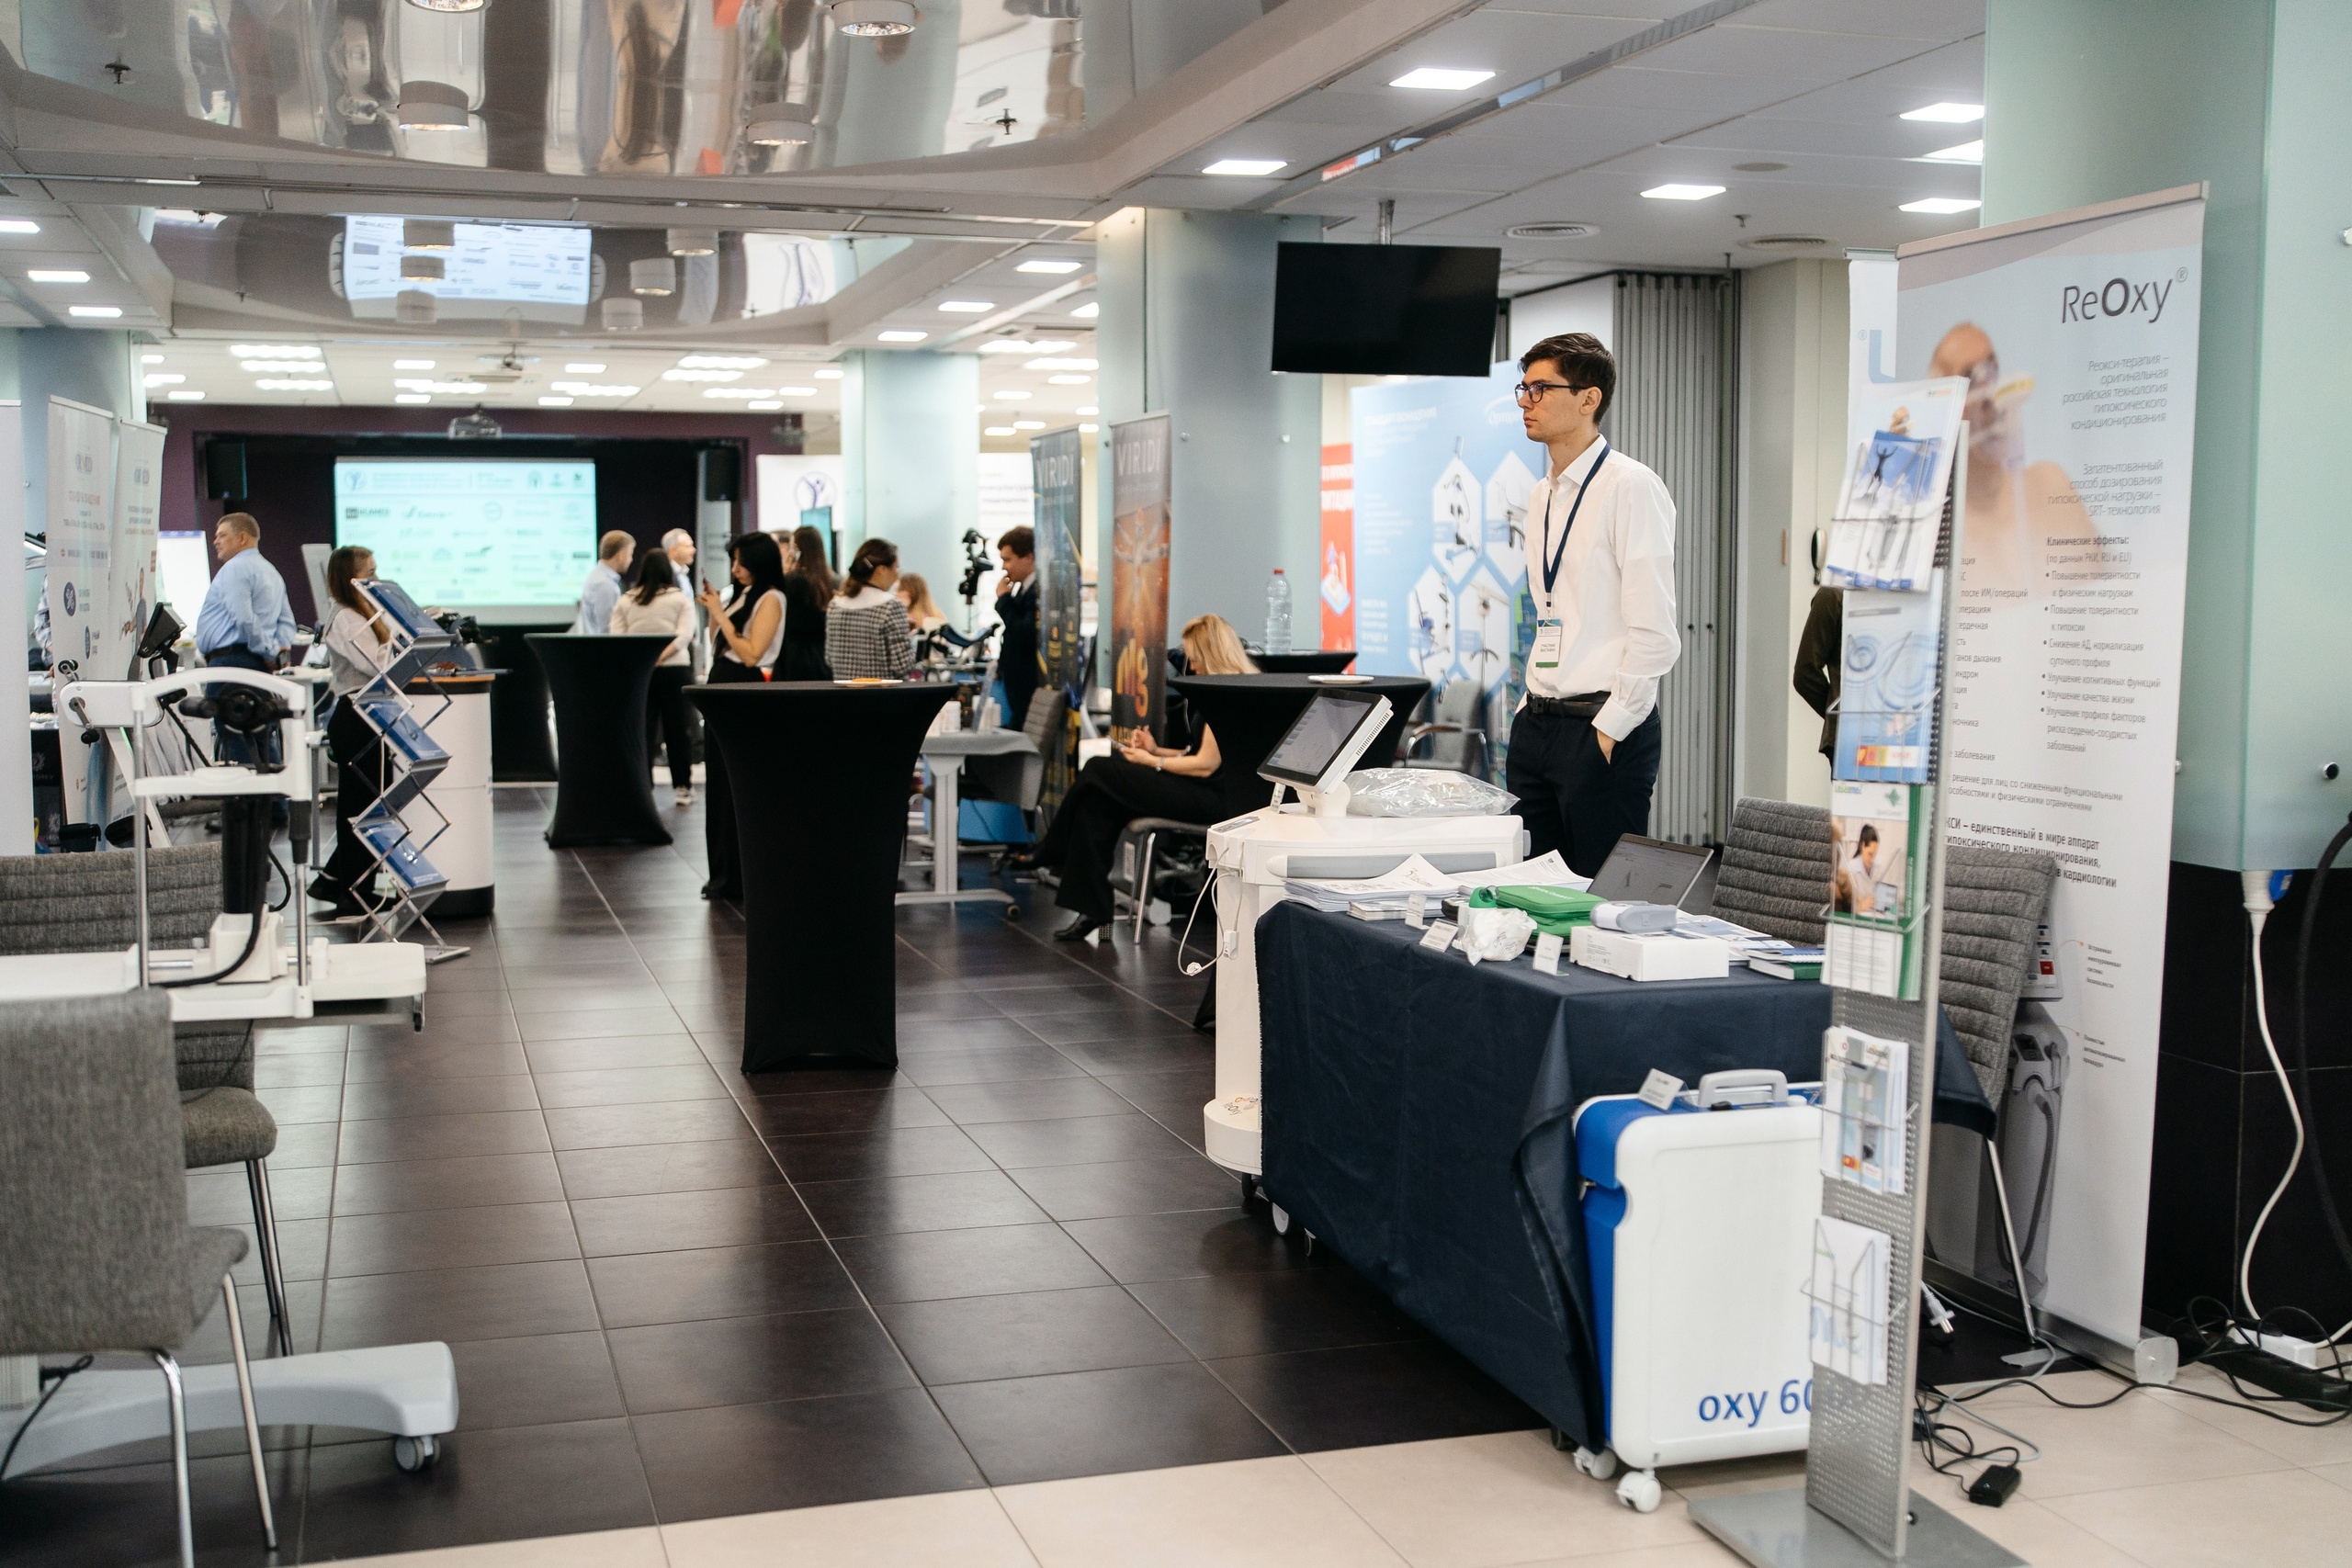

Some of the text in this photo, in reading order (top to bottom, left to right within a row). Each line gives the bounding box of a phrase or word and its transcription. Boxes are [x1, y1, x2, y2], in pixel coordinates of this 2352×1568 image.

[2088, 355, 2161, 371] Реокси-терапия
[2101, 369, 2168, 386] оригинальная
[2063, 384, 2168, 405] российская технология
[2094, 398, 2167, 413] гипоксического
[2072, 412, 2166, 430] кондиционирования
[2084, 459, 2164, 475] Запатентованный
[2071, 475, 2163, 491] способ дозирования
[2048, 491, 2109, 504] гипоксической
[2112, 491, 2153, 504] нагрузки
[2108, 504, 2161, 516] технология
[2047, 536, 2129, 547] Клинические эффекты:
[2059, 553, 2084, 564] данным
[2052, 570, 2141, 581] Повышение толерантности
[1962, 590, 1980, 598] после
[2059, 588, 2096, 599] физическим
[2098, 589, 2133, 600] нагрузкам
[2051, 604, 2139, 616] Повышение толерантности
[1959, 622, 1989, 630] ердечная
[2057, 624, 2086, 632] гипоксии
[2050, 638, 2080, 649] Снижение
[2094, 641, 2144, 651] нормализация
[2050, 658, 2110, 669] суточного профиля
[1955, 671, 1979, 680] индром
[2047, 672, 2161, 689] Улучшение когнитивных функций
[2047, 689, 2135, 705] Улучшение качества жизни
[2046, 705, 2146, 723] Улучшение профиля факторов
[2048, 725, 2138, 740] риска сердечно-сосудистых
[2047, 740, 2086, 753] заболеваний
[1954, 749, 1996, 761] заболевания
[1952, 774, 1980, 784] решение
[1982, 777, 1994, 785] для
[1996, 779, 2008, 788] лиц
[2020, 782, 2063, 794] сниженными
[2064, 784, 2123, 801] функциональными
[1948, 786, 1989, 798] особностями
[1998, 791, 2044, 805] физическими
[2046, 799, 2092, 811] ограничениями
[1971, 823, 2036, 840] единственный
[2039, 832, 2043, 841] в
[2046, 833, 2066, 846] мире
[2068, 837, 2100, 852] аппарат
[2064, 869, 2117, 888] кардиологии
[1699, 1390, 1769, 1428] oxy
